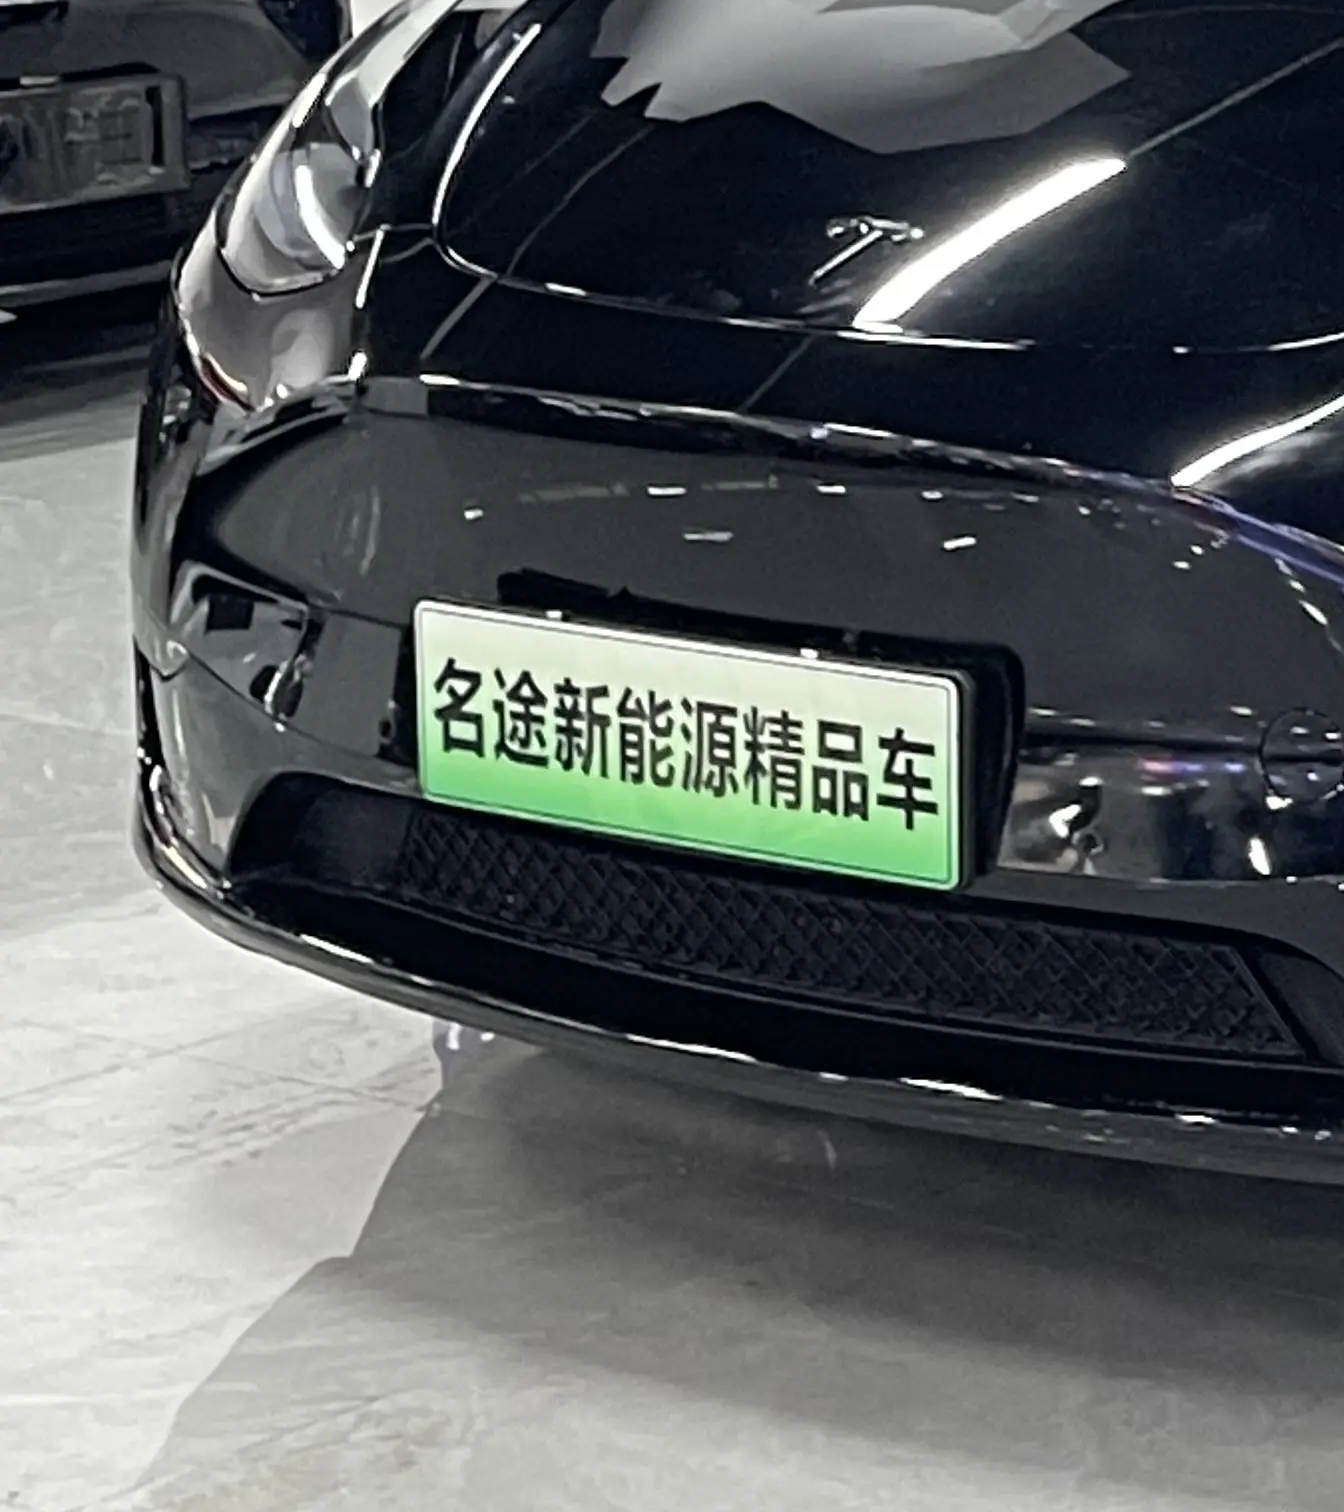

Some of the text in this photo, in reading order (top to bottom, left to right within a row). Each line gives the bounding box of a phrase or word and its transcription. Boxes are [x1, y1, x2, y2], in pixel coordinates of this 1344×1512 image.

[433, 656, 939, 831] 名途新能源精品车
